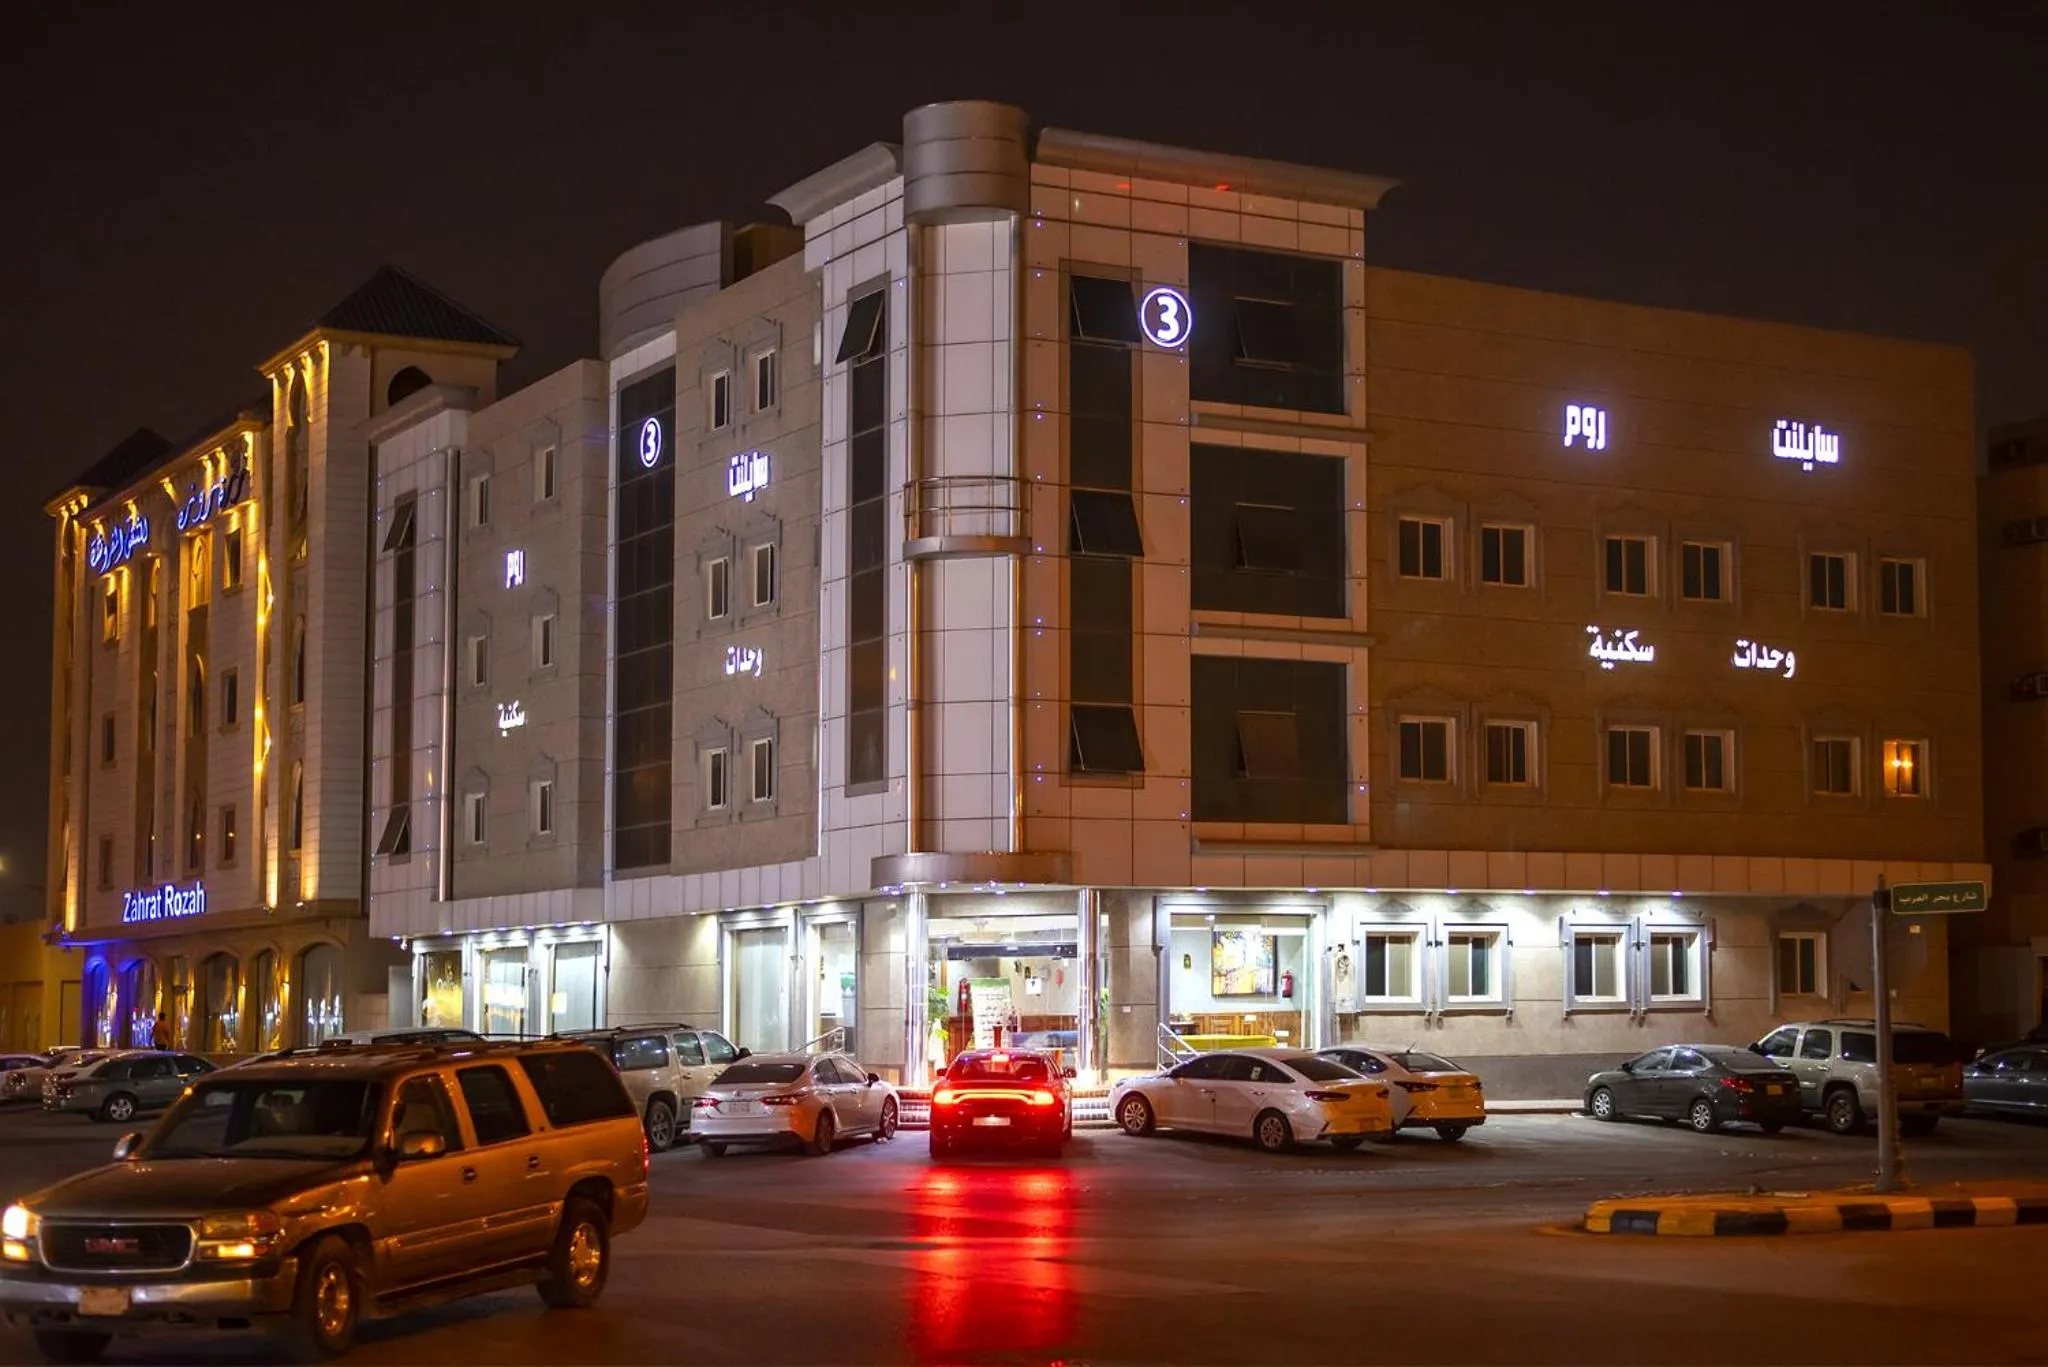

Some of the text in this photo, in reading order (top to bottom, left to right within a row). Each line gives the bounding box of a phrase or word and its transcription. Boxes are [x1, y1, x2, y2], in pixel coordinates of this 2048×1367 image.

[1157, 295, 1180, 342] 3
[645, 424, 657, 460] 3
[1564, 404, 1839, 471] سايلنت روم
[725, 645, 763, 677] وحدات
[1586, 626, 1795, 677] وحدات سكنية
[123, 881, 205, 922] Zahrat Rozah
